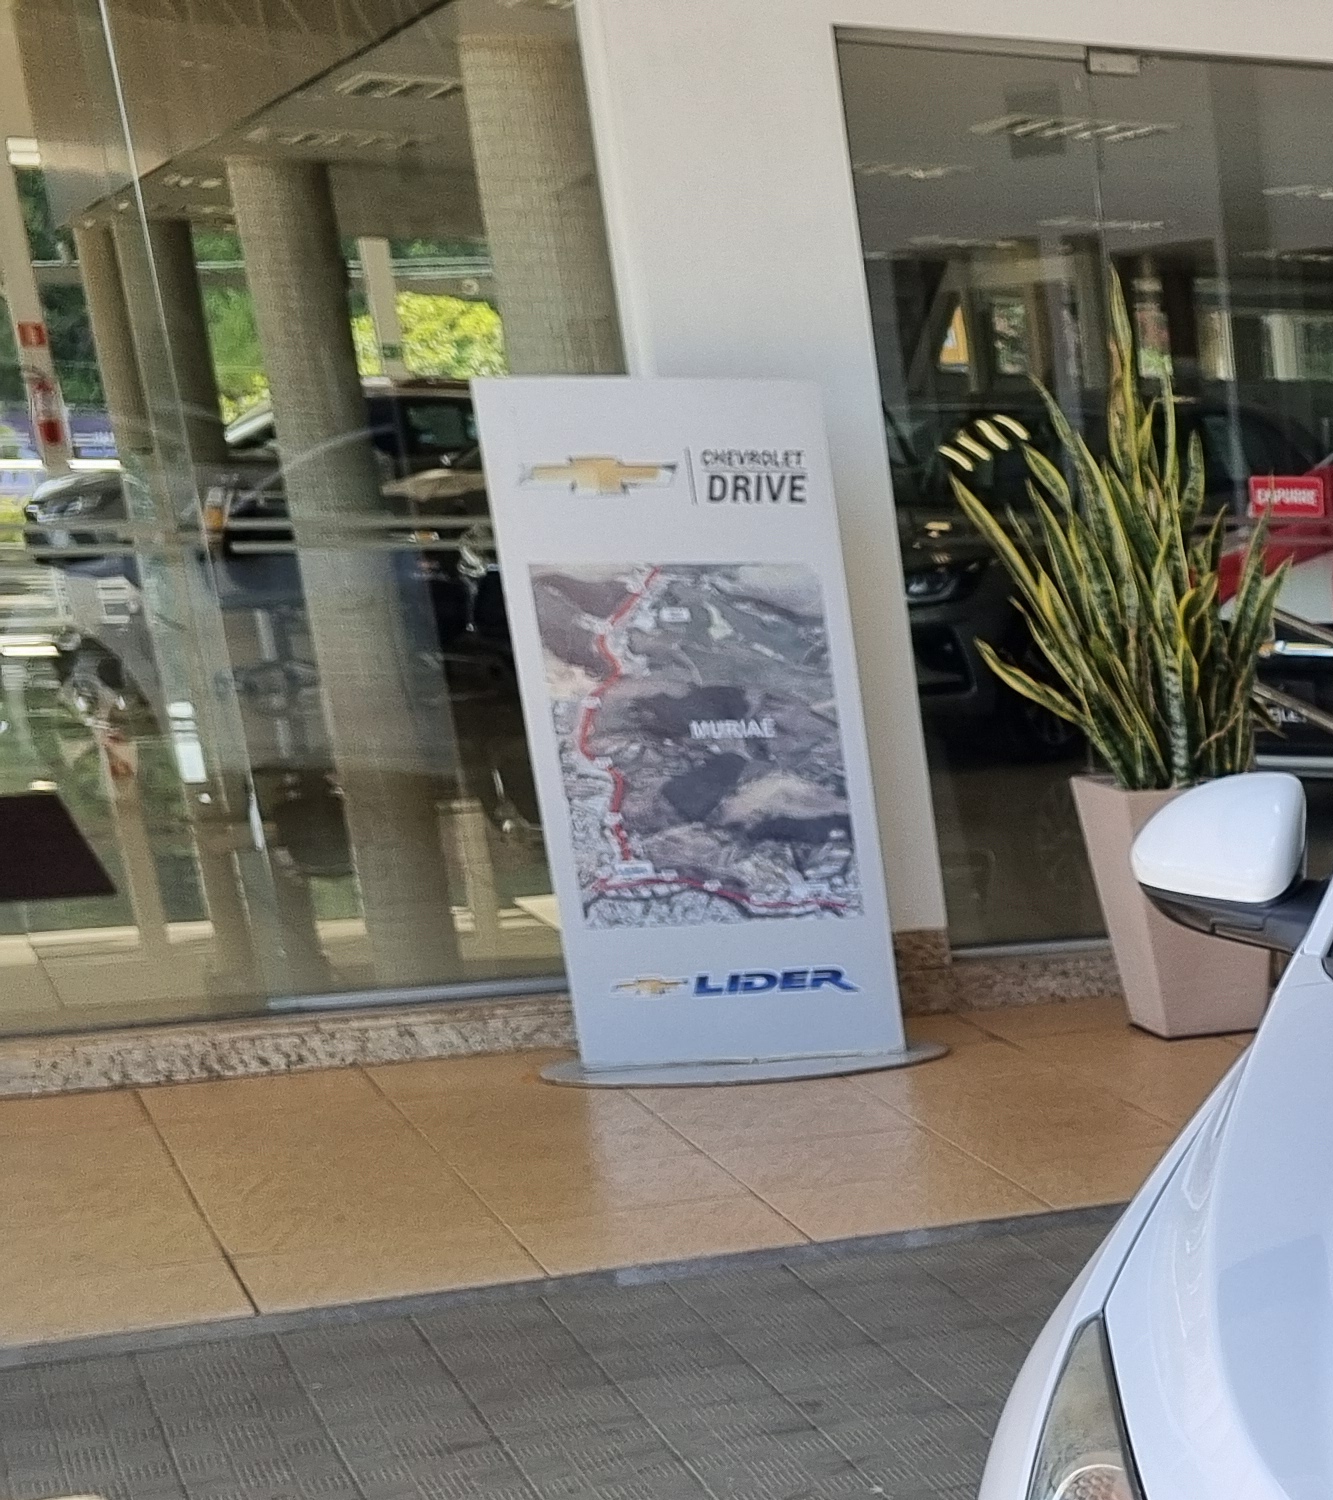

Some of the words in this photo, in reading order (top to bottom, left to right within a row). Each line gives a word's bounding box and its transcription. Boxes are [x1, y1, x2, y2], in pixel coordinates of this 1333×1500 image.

[701, 448, 805, 467] CHEVROLET
[708, 474, 807, 503] DRIVE
[694, 967, 862, 997] LIDER
